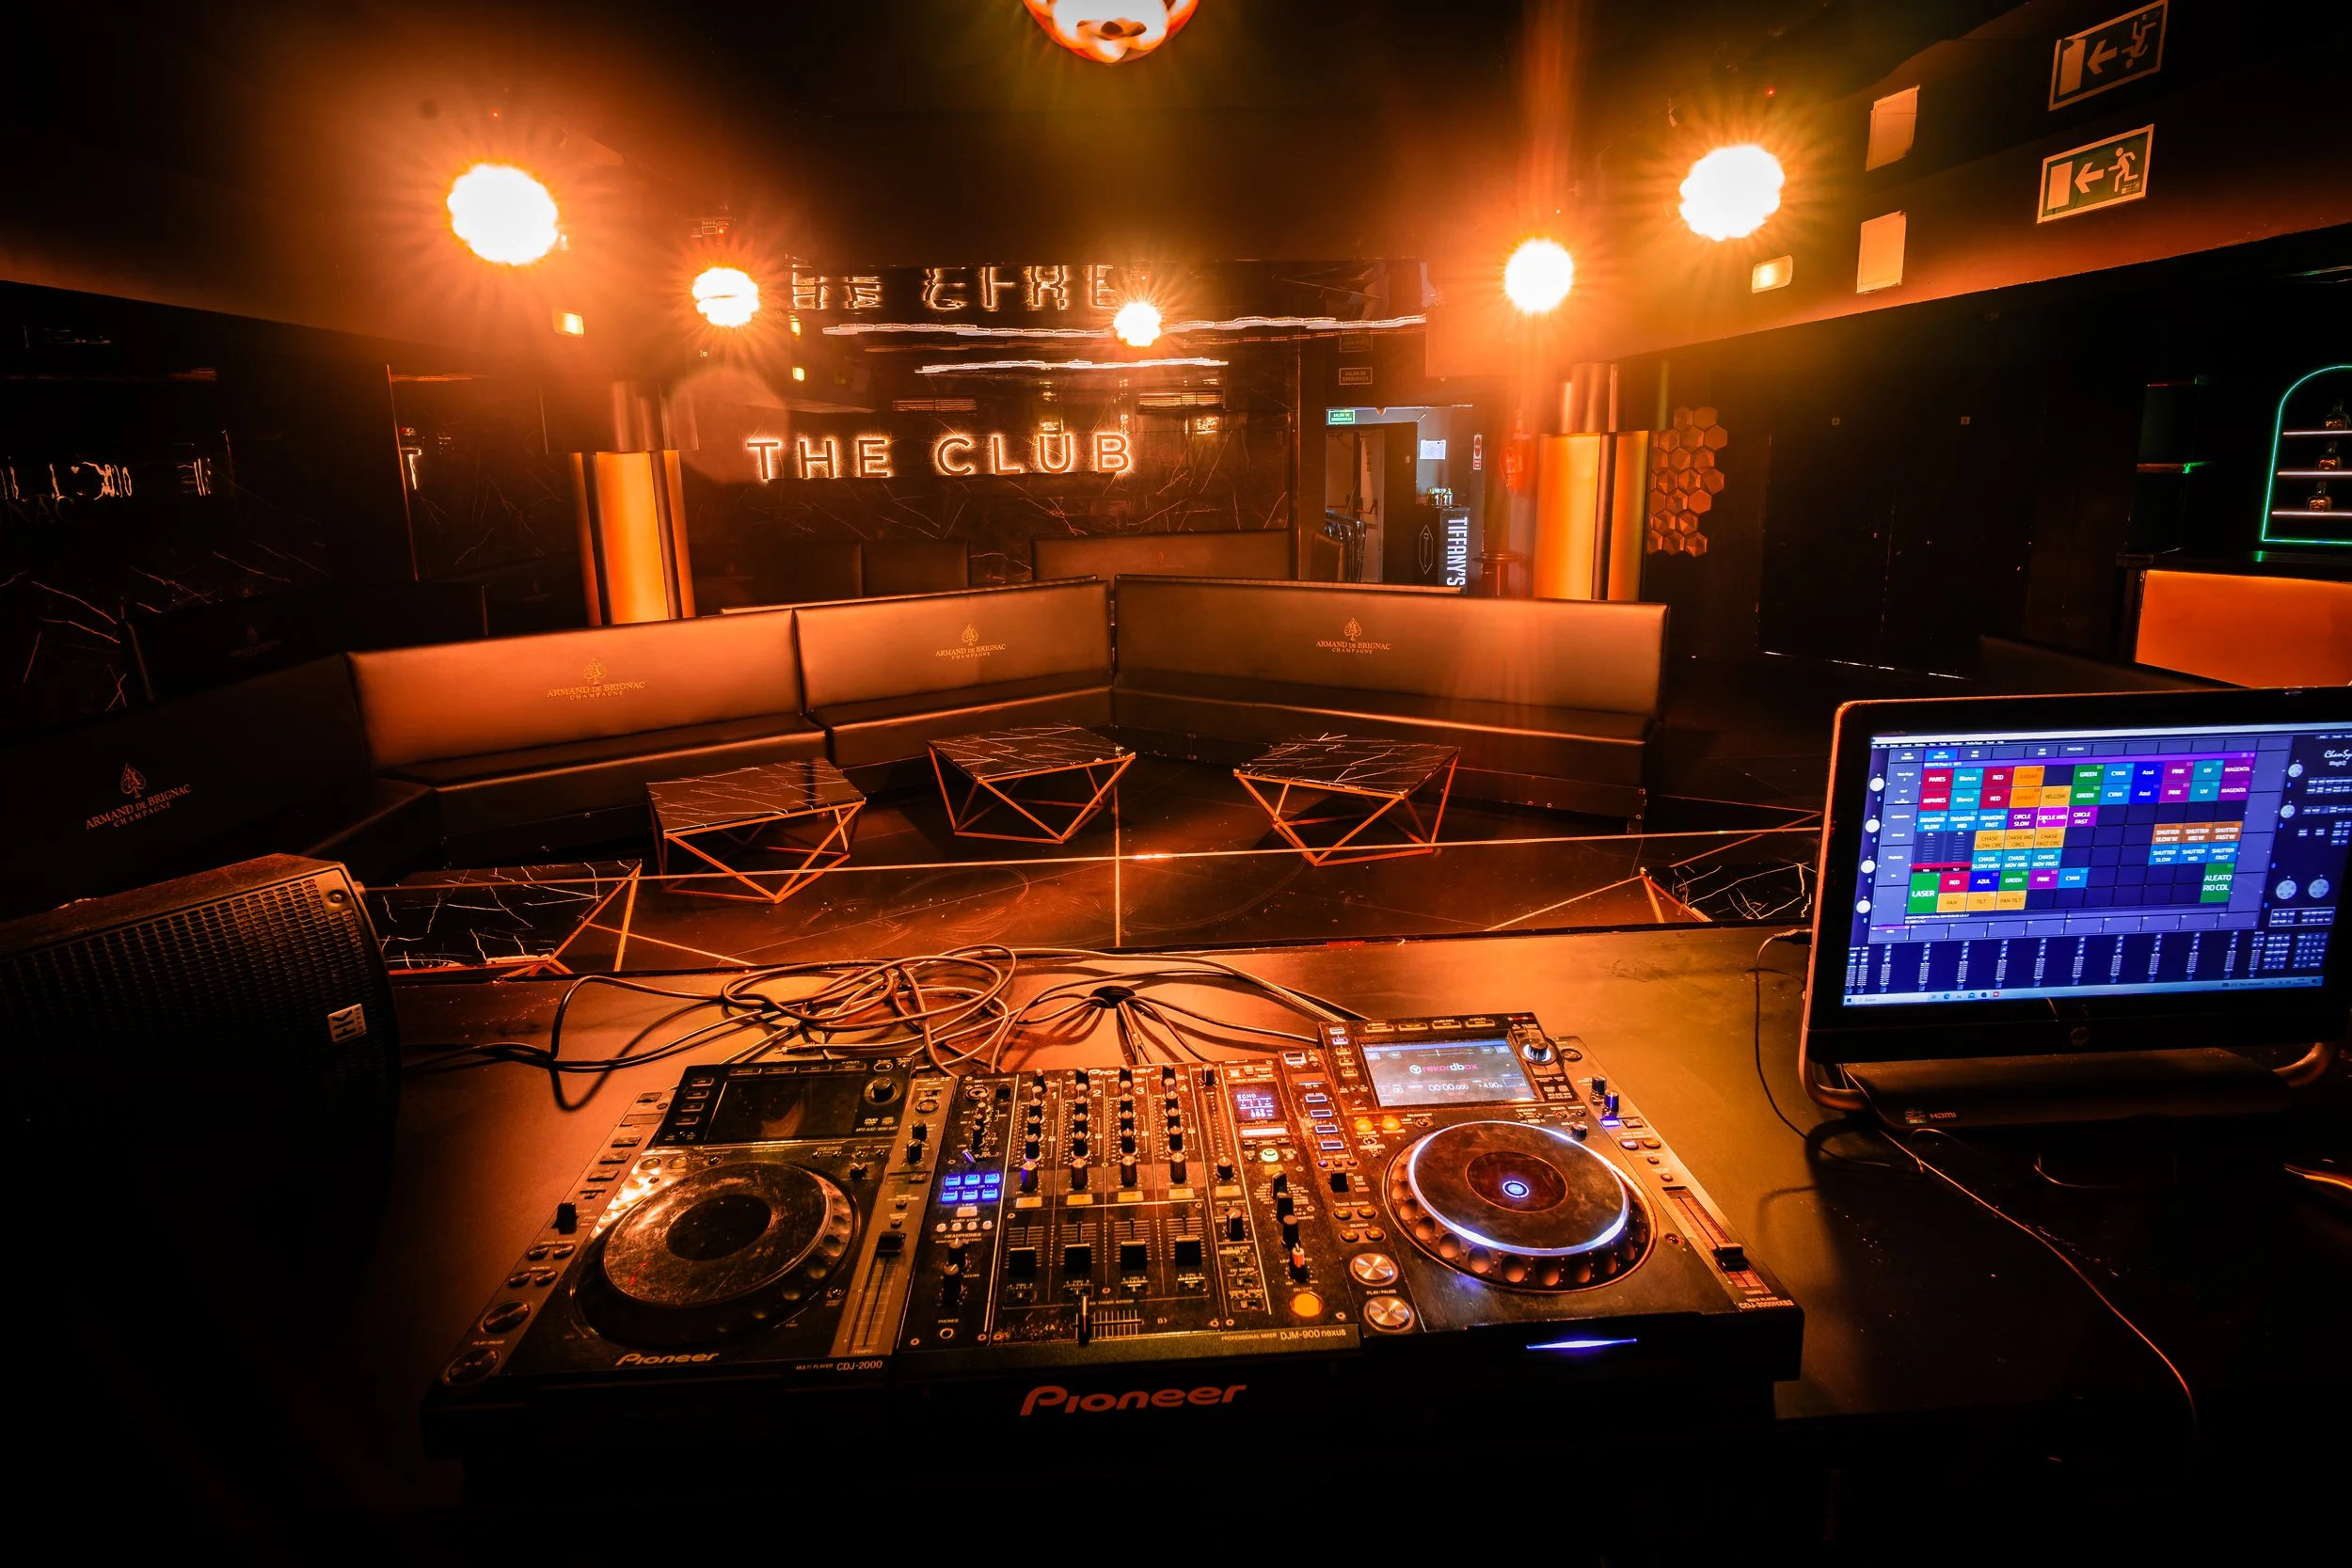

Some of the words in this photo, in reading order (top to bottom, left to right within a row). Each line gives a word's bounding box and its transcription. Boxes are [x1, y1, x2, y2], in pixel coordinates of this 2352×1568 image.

[747, 437, 891, 481] THE
[935, 433, 1132, 477] CLUB
[1447, 516, 1468, 586] TIFFANY'S
[935, 647, 966, 657] ARMAND
[976, 643, 1007, 653] BRIGNAC
[1316, 641, 1347, 649] ARMAND
[1358, 641, 1391, 650] BRIGNAC
[951, 652, 991, 660] CHAMPAGNE
[547, 686, 590, 698] ARMAND
[604, 681, 645, 692] BRIGNAC
[569, 690, 624, 701] CHAMPAGNE
[86, 804, 134, 830] ARMAND
[135, 800, 148, 812] DE
[148, 784, 192, 806] BRIGNAC
[113, 801, 172, 828] CHAMPAGNE
[331, 1009, 355, 1038] HK
[1422, 1062, 1479, 1073] rekordbox
[1279, 1329, 1321, 1340] DJM-900
[1321, 1328, 1346, 1337] nexus
[615, 1353, 720, 1366] Pioneer
[836, 1360, 883, 1370] CDJ-2000
[1020, 1385, 1248, 1417] Pioneer
